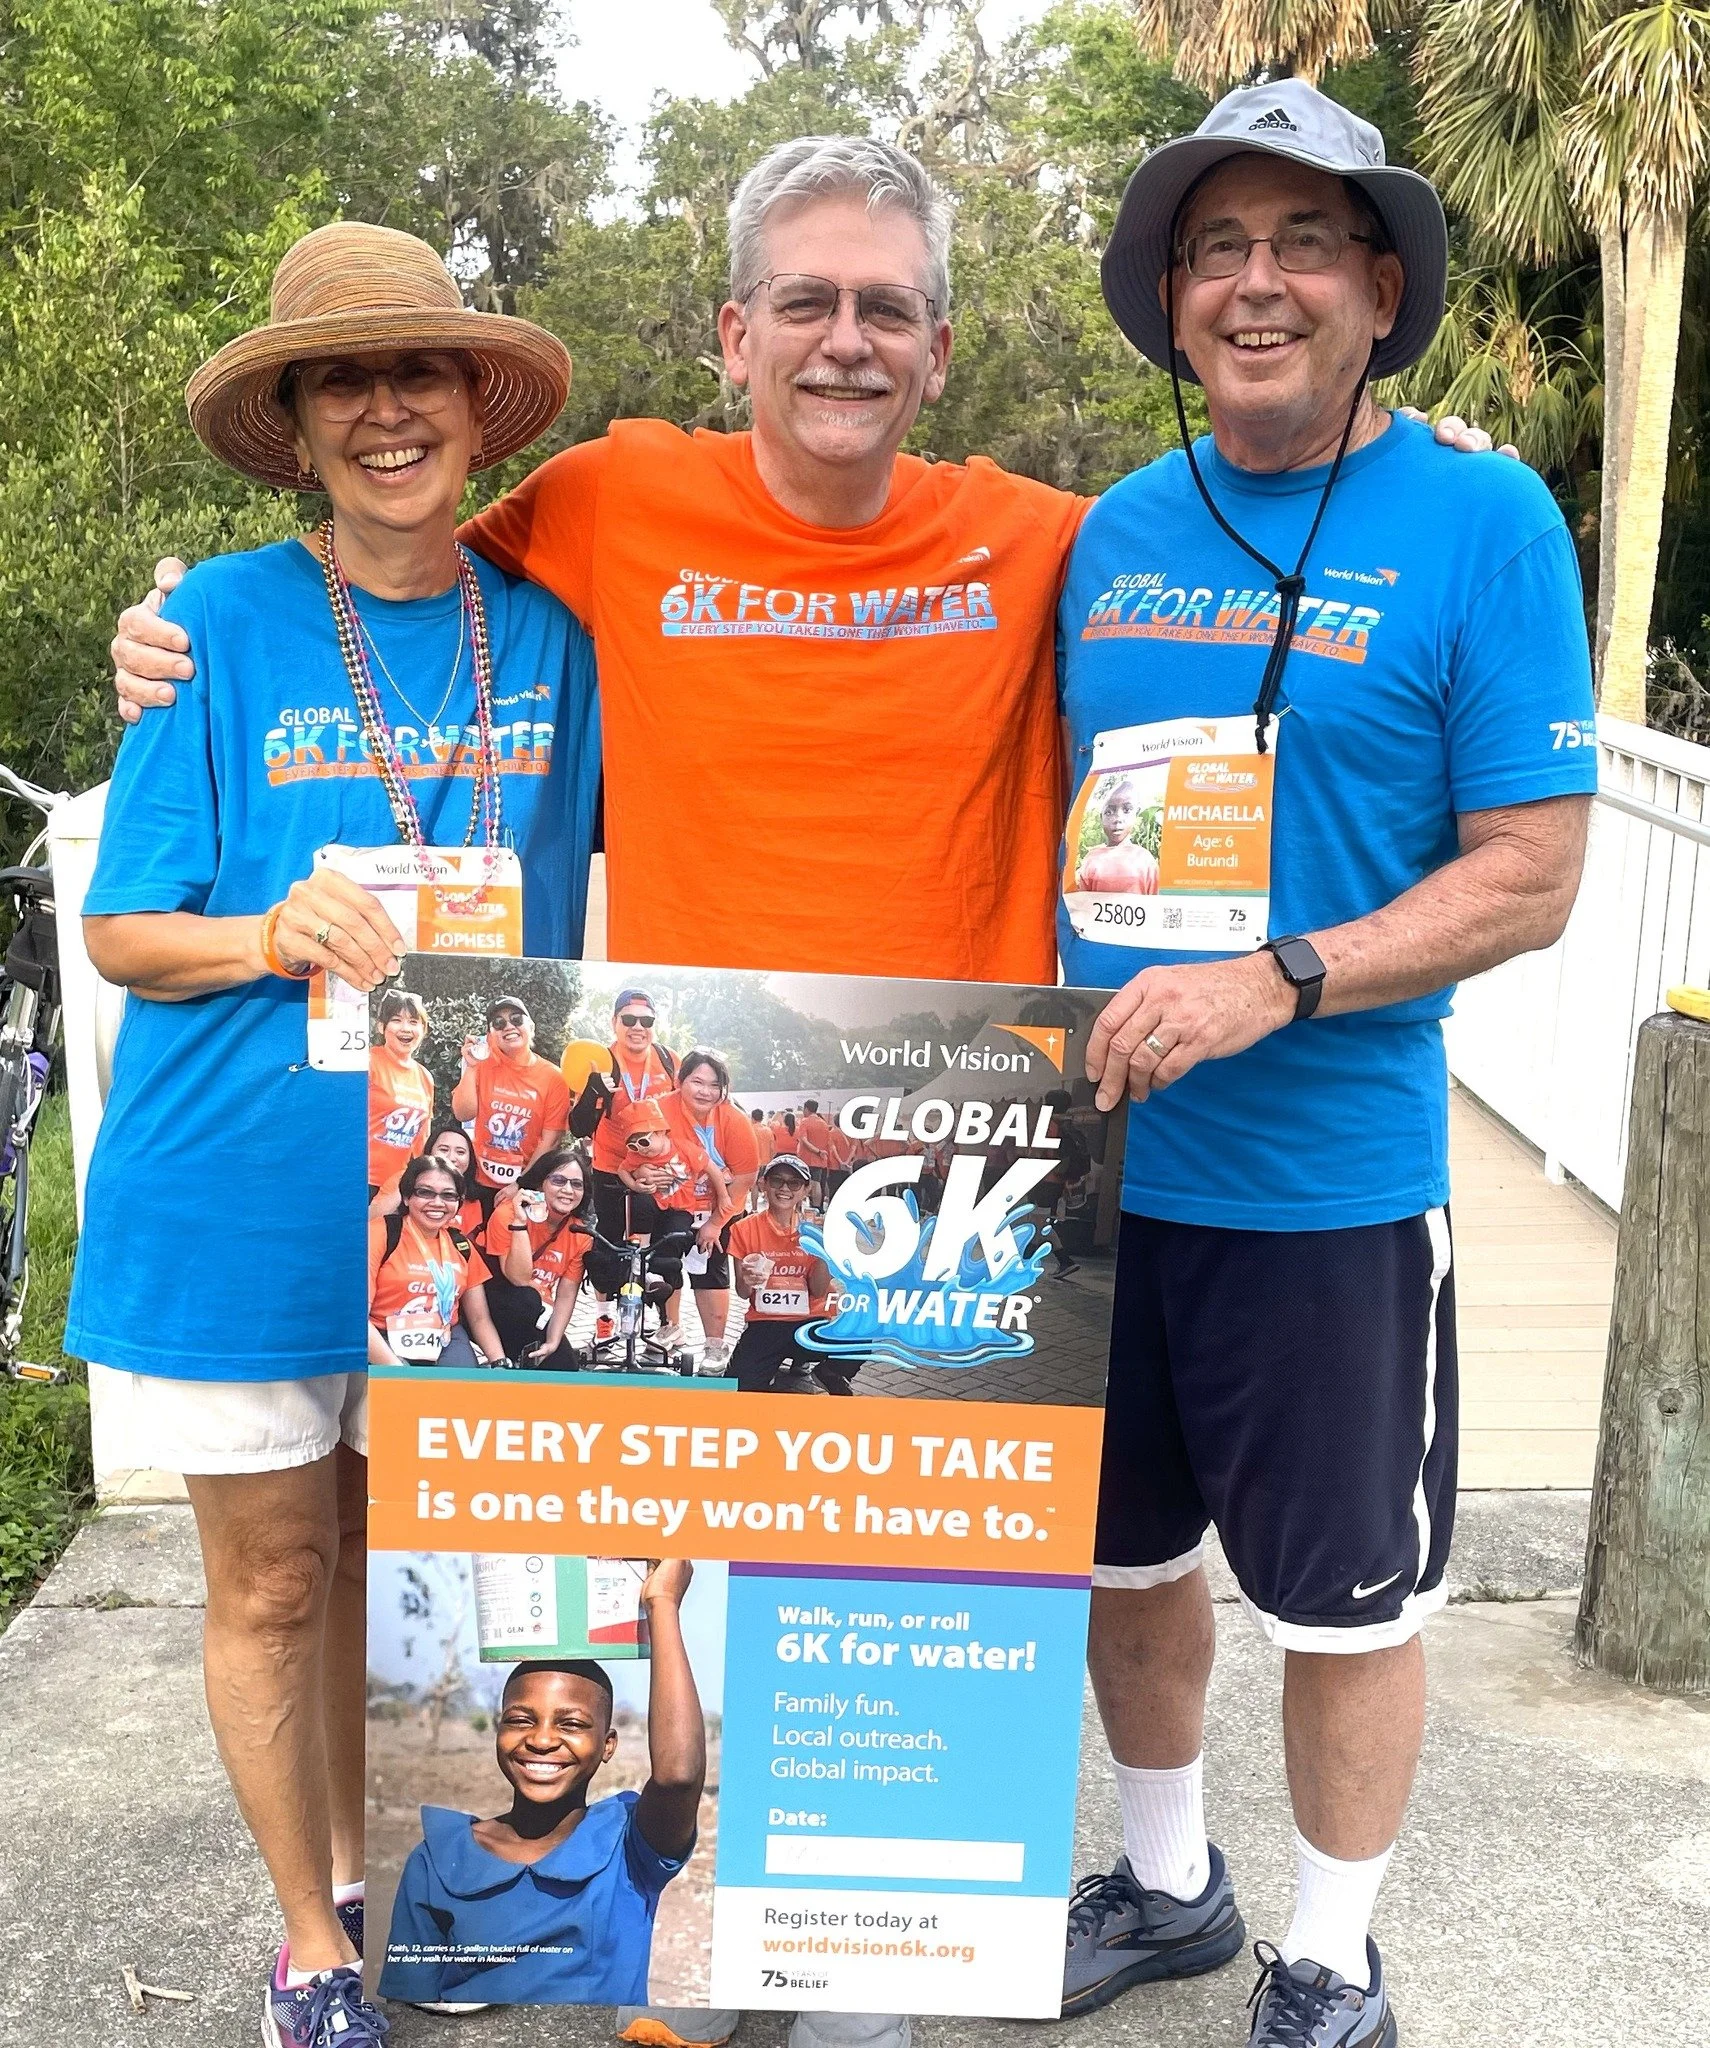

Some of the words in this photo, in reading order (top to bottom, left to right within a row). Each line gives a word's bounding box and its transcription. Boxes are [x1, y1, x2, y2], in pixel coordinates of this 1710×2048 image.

[1248, 120, 1298, 132] adidas
[1112, 572, 1167, 589] GLOBAL
[1323, 566, 1353, 581] World
[1354, 569, 1385, 585] Vision
[660, 583, 727, 622] 6K
[737, 583, 837, 623] FOR
[848, 581, 994, 625] WATER
[1127, 587, 1214, 626] FOR
[680, 623, 720, 635] EVERY
[722, 623, 753, 635] STEP
[756, 623, 784, 635] YOU
[788, 625, 820, 636] TAKE
[823, 626, 835, 637] IS
[837, 628, 863, 638] ONE
[934, 620, 964, 632] HAVE
[491, 694, 520, 706] World
[279, 706, 355, 727] GLOBAL
[1142, 736, 1170, 753] World
[1173, 736, 1204, 749] Vision
[1549, 721, 1582, 750] 75
[263, 726, 329, 768] 6K
[1187, 761, 1230, 774] GLOBAL
[1167, 804, 1265, 822] MICHAELLA
[1192, 834, 1222, 851] Age:
[1224, 835, 1234, 848] 6
[375, 863, 410, 875] World
[1187, 853, 1239, 868] Burundi
[1092, 902, 1146, 927] 25809
[1229, 908, 1247, 922] 75
[432, 932, 505, 949] JOPHESE
[840, 1039, 931, 1068] World
[940, 1044, 1030, 1073] Vision
[490, 1100, 532, 1118] GLOBAL
[488, 1112, 531, 1140] 6K
[839, 1095, 1062, 1149] GLOBAL
[822, 1154, 1062, 1282] 6K
[762, 1292, 801, 1305] 6217
[824, 1292, 870, 1313] FOR
[877, 1288, 1033, 1331] WATER
[417, 1416, 605, 1464] EVERY
[619, 1424, 760, 1470] STEP
[774, 1429, 895, 1476] YOU
[911, 1435, 1054, 1482] TAKE
[416, 1479, 457, 1520] is
[470, 1492, 565, 1523] one
[576, 1485, 691, 1538] they
[701, 1494, 842, 1534] won't
[854, 1494, 972, 1538] have
[777, 1605, 843, 1629] Walk,
[848, 1612, 895, 1631] run,
[900, 1614, 926, 1630] or
[930, 1612, 970, 1632] roll
[776, 1632, 831, 1665] 6K
[840, 1632, 900, 1667] for
[909, 1640, 1037, 1673] water!
[773, 1691, 850, 1720] Family
[855, 1693, 900, 1717] fun.
[772, 1724, 833, 1748] Local
[839, 1729, 949, 1751] outreach.
[770, 1757, 846, 1780] Global
[853, 1760, 940, 1787] impact.
[768, 1807, 828, 1828] Date:
[764, 1907, 848, 1930] Register
[854, 1911, 913, 1934] today
[918, 1913, 939, 1930] at
[388, 1944, 410, 1954] Faith,
[424, 1945, 449, 1953] carries
[456, 1944, 489, 1955] 5-gallon
[489, 1945, 517, 1954] bucket
[517, 1945, 529, 1954] full
[530, 1945, 539, 1954] of
[539, 1946, 562, 1955] water
[388, 1955, 402, 1963] her
[402, 1955, 422, 1965] daily
[422, 1955, 442, 1964] walk
[441, 1955, 454, 1964] for
[454, 1956, 477, 1964] water
[477, 1955, 486, 1964] in
[486, 1955, 518, 1964] Malawi.
[763, 1936, 976, 1964] worldvision6k.org
[761, 1969, 788, 1988] 75
[790, 1979, 829, 1989] BELIEF
